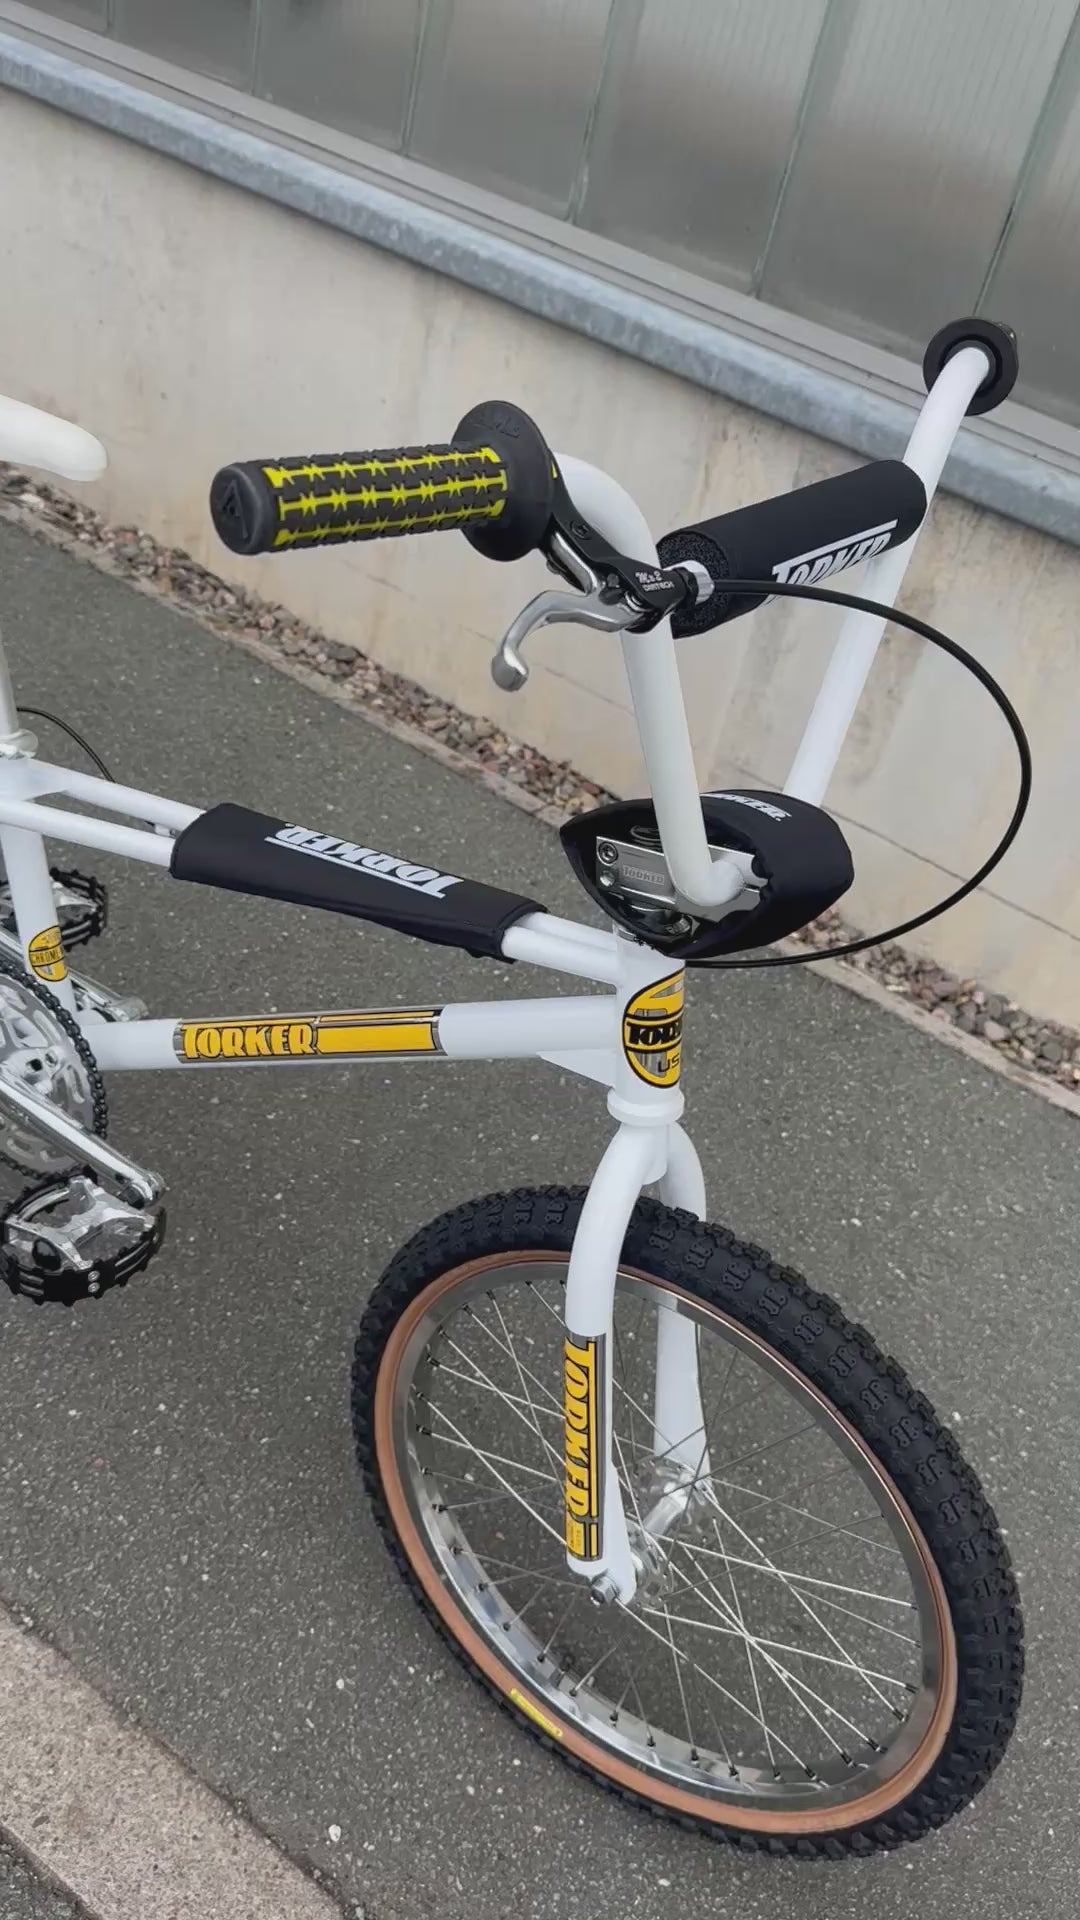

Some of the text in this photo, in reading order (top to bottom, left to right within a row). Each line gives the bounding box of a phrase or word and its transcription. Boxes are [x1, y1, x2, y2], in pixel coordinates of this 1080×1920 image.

[264, 823, 464, 899] TORKER
[180, 1018, 318, 1059] TORKER
[658, 1053, 681, 1073] US
